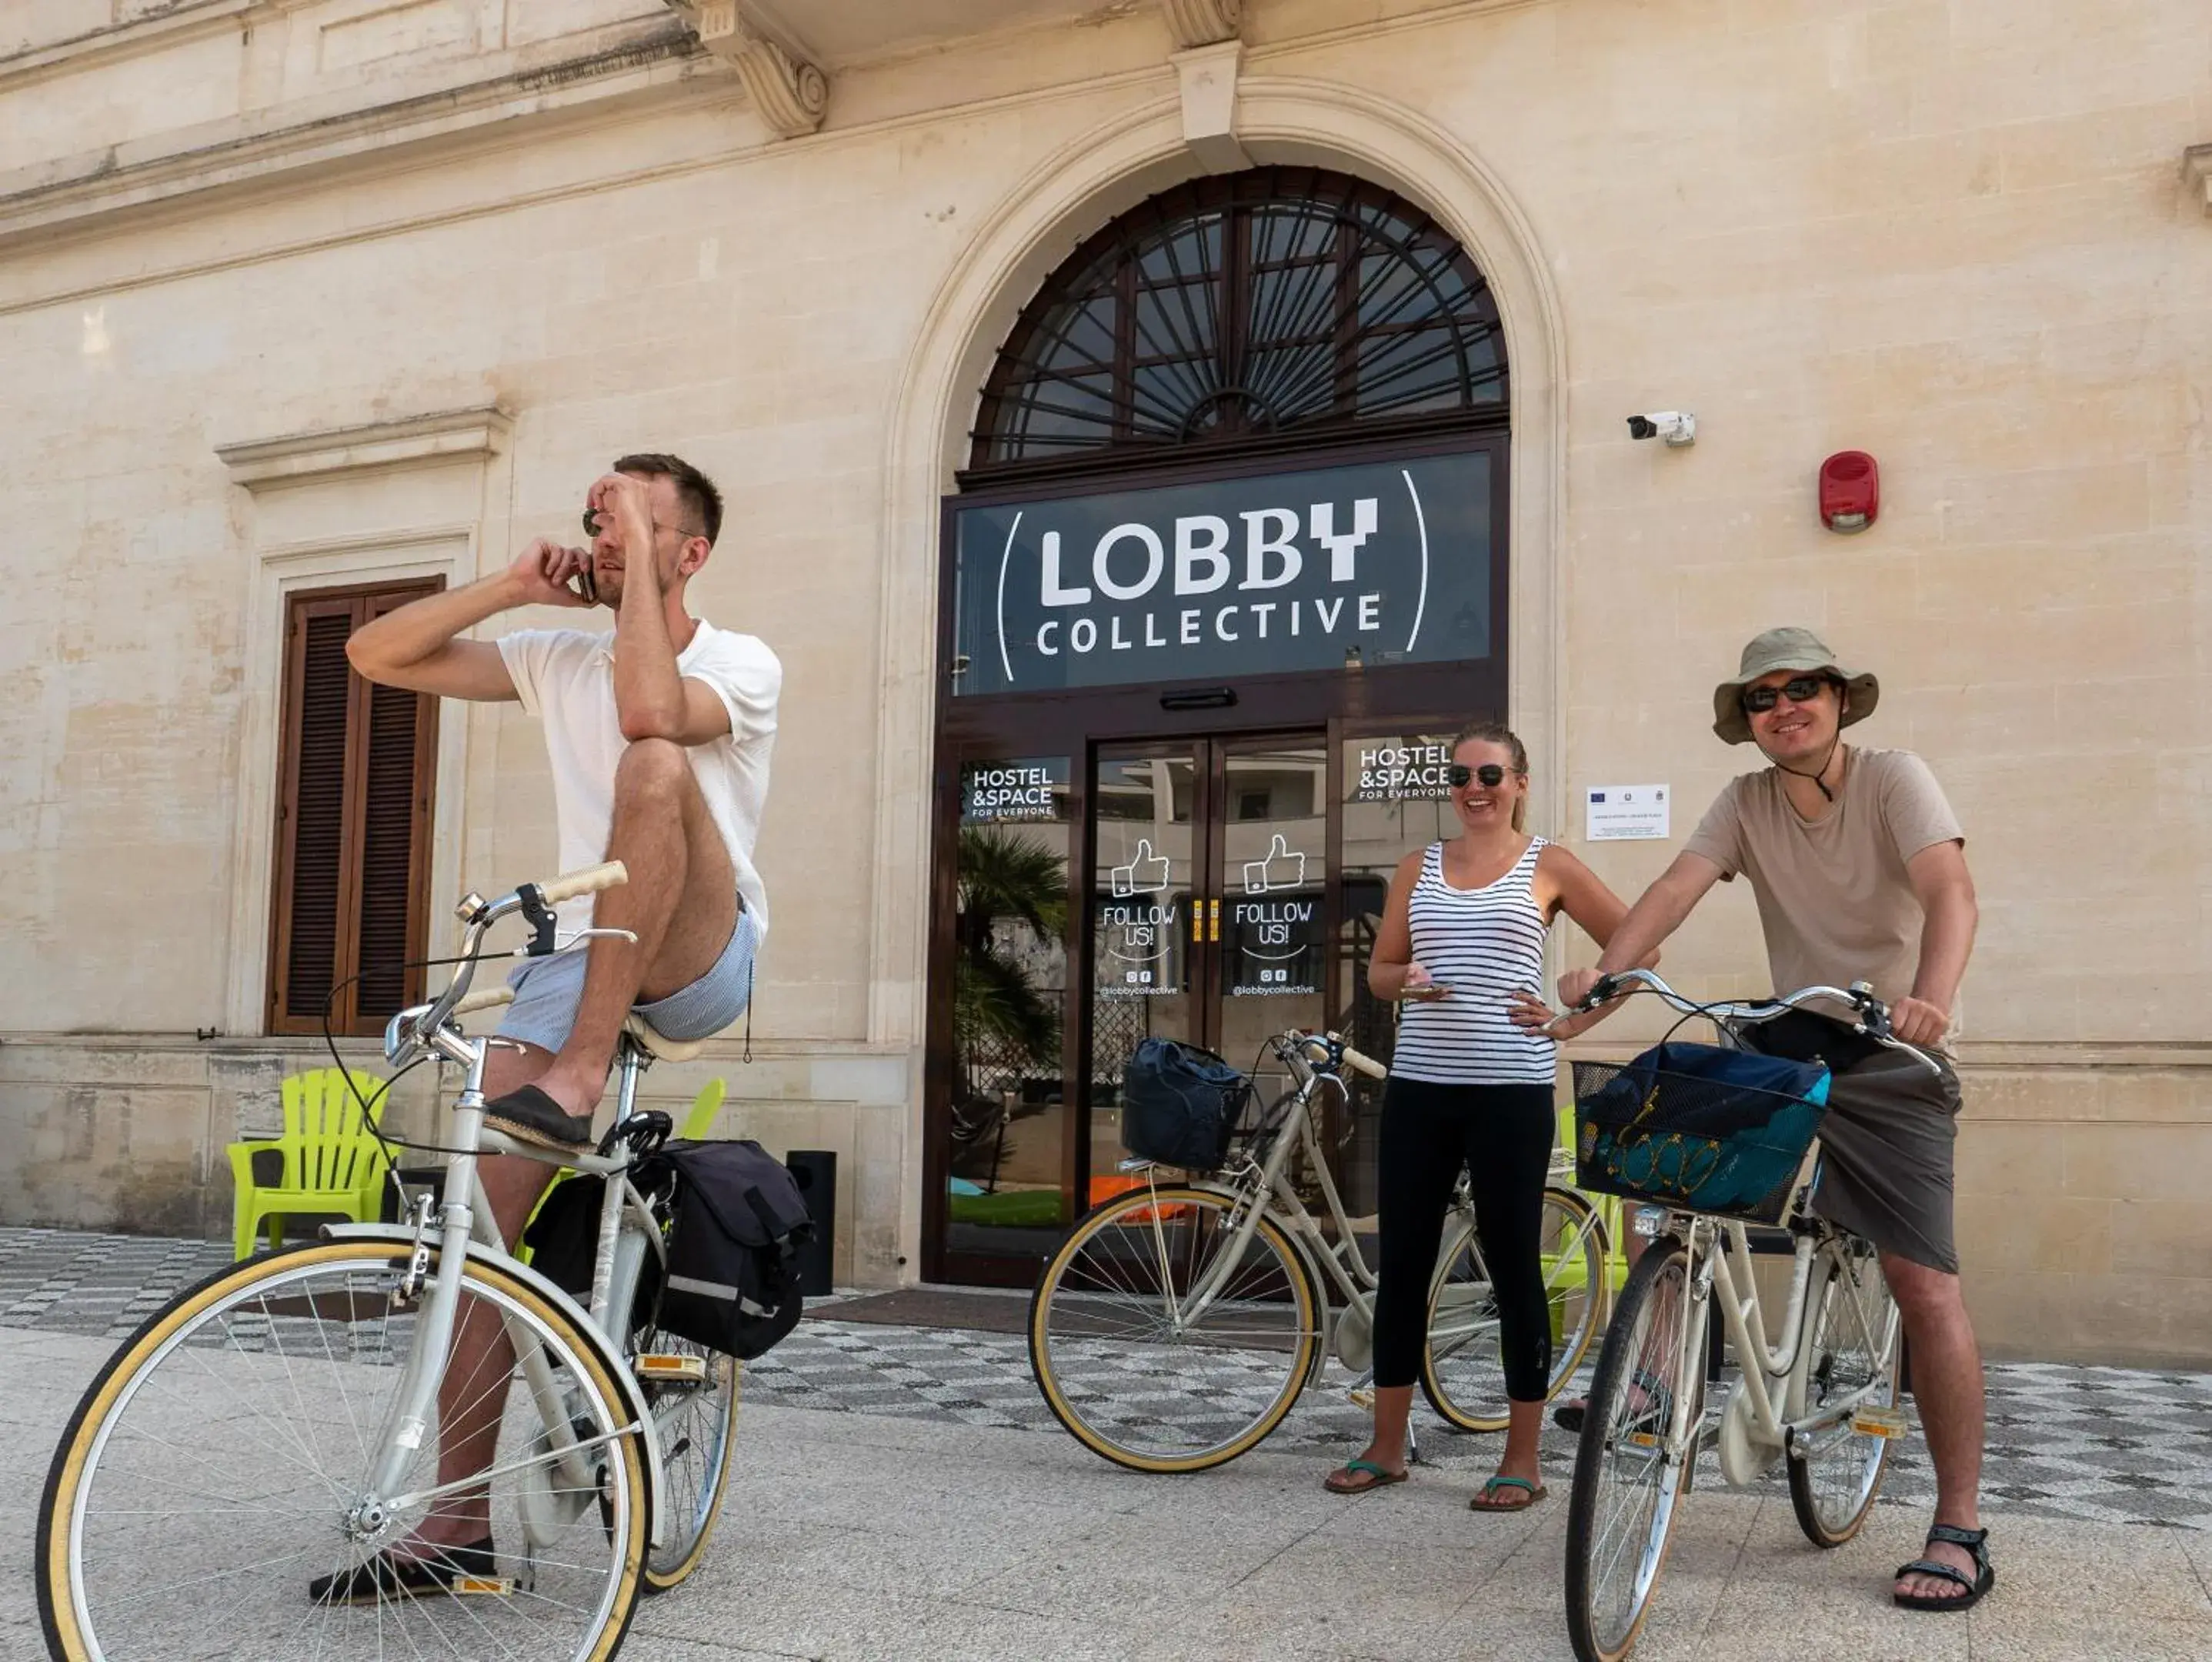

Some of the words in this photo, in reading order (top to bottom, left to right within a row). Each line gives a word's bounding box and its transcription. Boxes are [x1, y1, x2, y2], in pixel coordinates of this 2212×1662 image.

[1042, 499, 1378, 607] LOBBY
[1037, 594, 1380, 656] COLLECTIVE
[1360, 746, 1452, 767] HOSTEL
[974, 768, 1053, 786] HOSTEL
[1360, 766, 1450, 788] &SPACE
[972, 787, 1053, 806] &SPACE
[1359, 791, 1383, 799] FOR
[1388, 787, 1452, 799] EVERYONE
[972, 809, 993, 817] FOR
[996, 806, 1053, 816] EVERYONE
[1103, 906, 1176, 926] FOLLOW
[1236, 903, 1312, 924] FOLLOW
[1126, 926, 1154, 946] US!
[1259, 924, 1289, 944] US!
[1099, 986, 1179, 996] @lobbycollective
[1233, 984, 1315, 996] @lobbycollective
